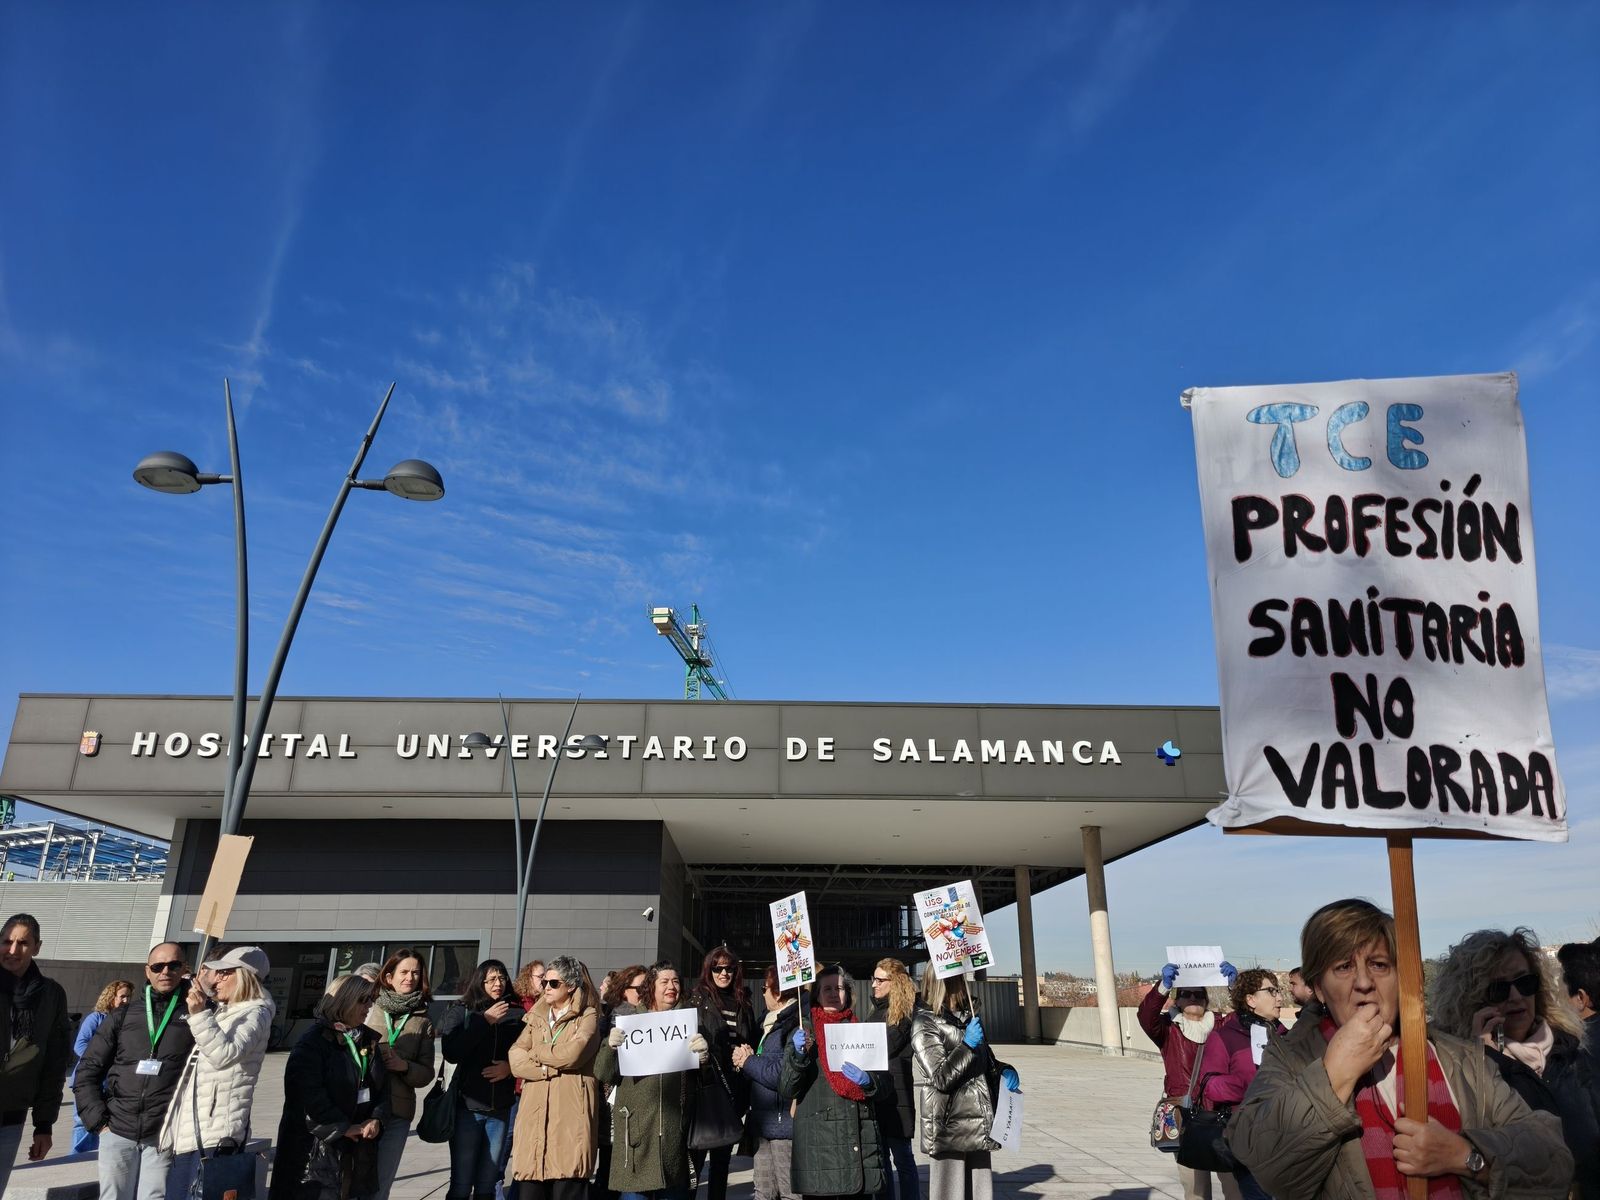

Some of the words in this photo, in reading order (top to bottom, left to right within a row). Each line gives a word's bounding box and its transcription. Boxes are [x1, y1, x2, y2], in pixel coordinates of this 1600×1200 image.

[1246, 401, 1429, 478] TCE
[1330, 672, 1414, 739] NO
[786, 737, 835, 761] DE
[873, 738, 1122, 764] SALAMANCA
[1263, 741, 1557, 819] VALORADA
[936, 943, 982, 962] NOVIEMBRE
[945, 941, 956, 951] 28
[957, 938, 968, 947] DE
[781, 958, 809, 973] NOVIEMBRE
[660, 1024, 688, 1042] YA!
